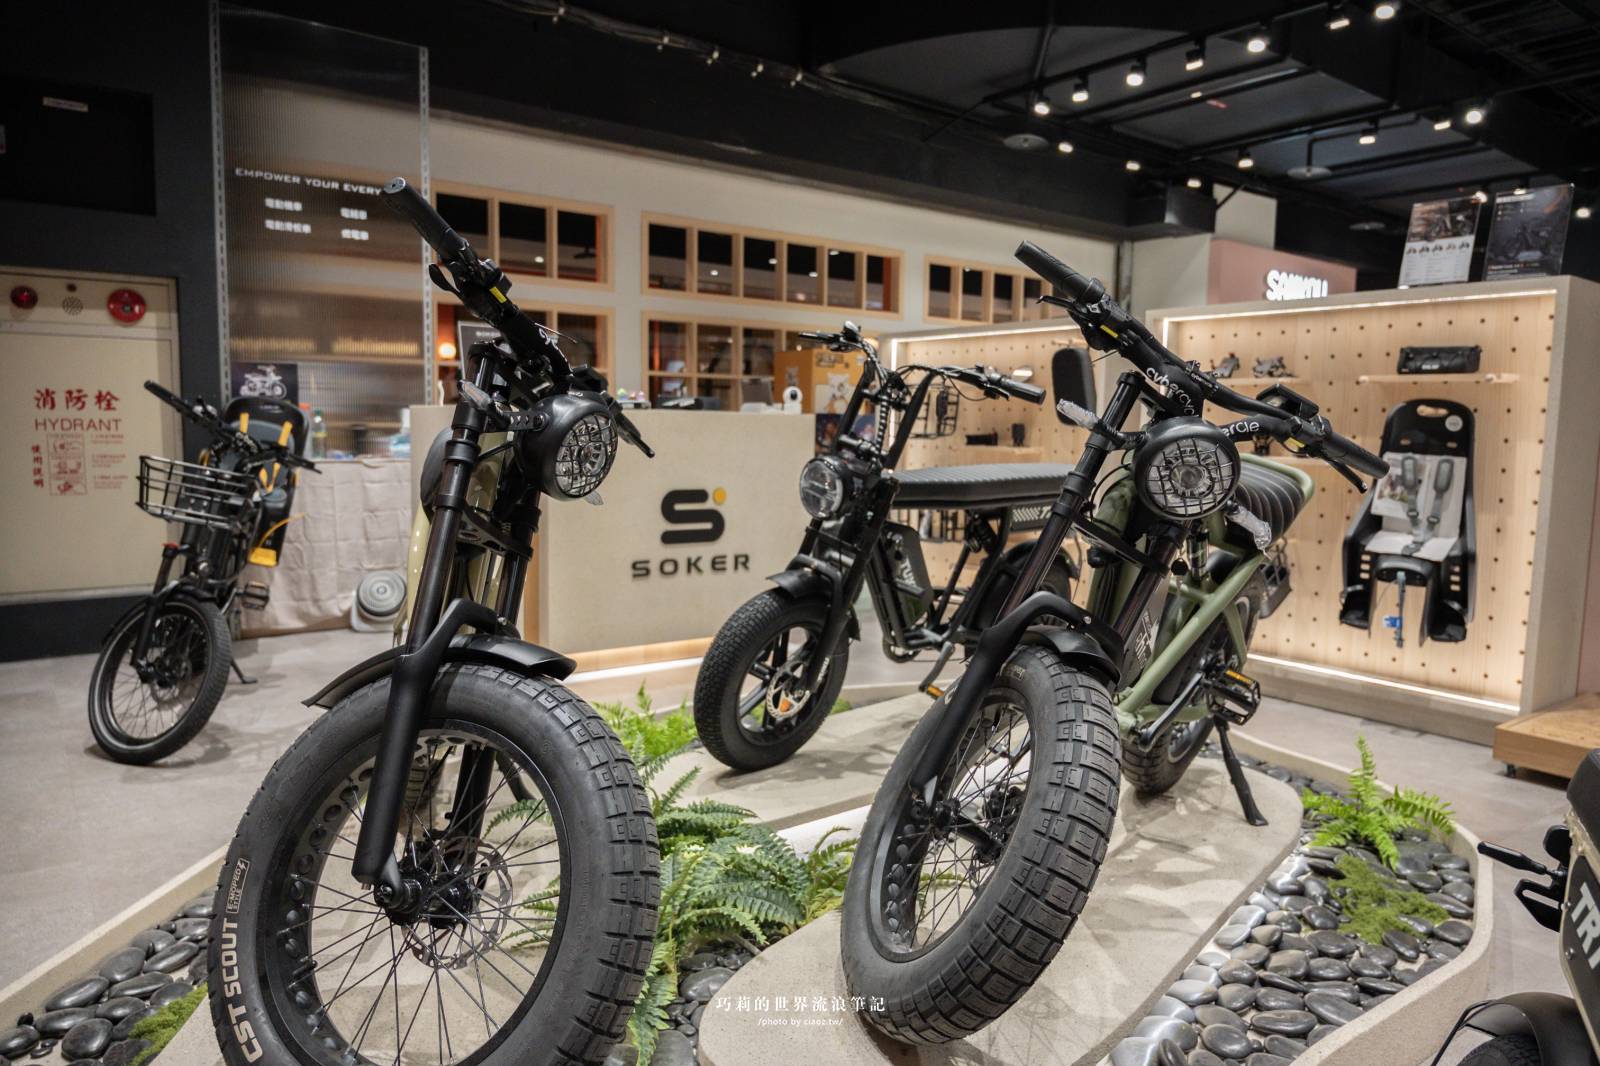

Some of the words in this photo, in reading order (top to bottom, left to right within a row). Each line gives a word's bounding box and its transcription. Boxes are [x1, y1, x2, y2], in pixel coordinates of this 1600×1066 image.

[235, 168, 301, 185] EMPOWER
[304, 177, 340, 190] YOUR
[343, 183, 382, 196] EVERY
[33, 387, 120, 412] 消防栓
[34, 417, 122, 432] HYDRANT
[631, 553, 750, 579] SOKER
[221, 917, 242, 998] SCOUT
[227, 1002, 264, 1064] CST
